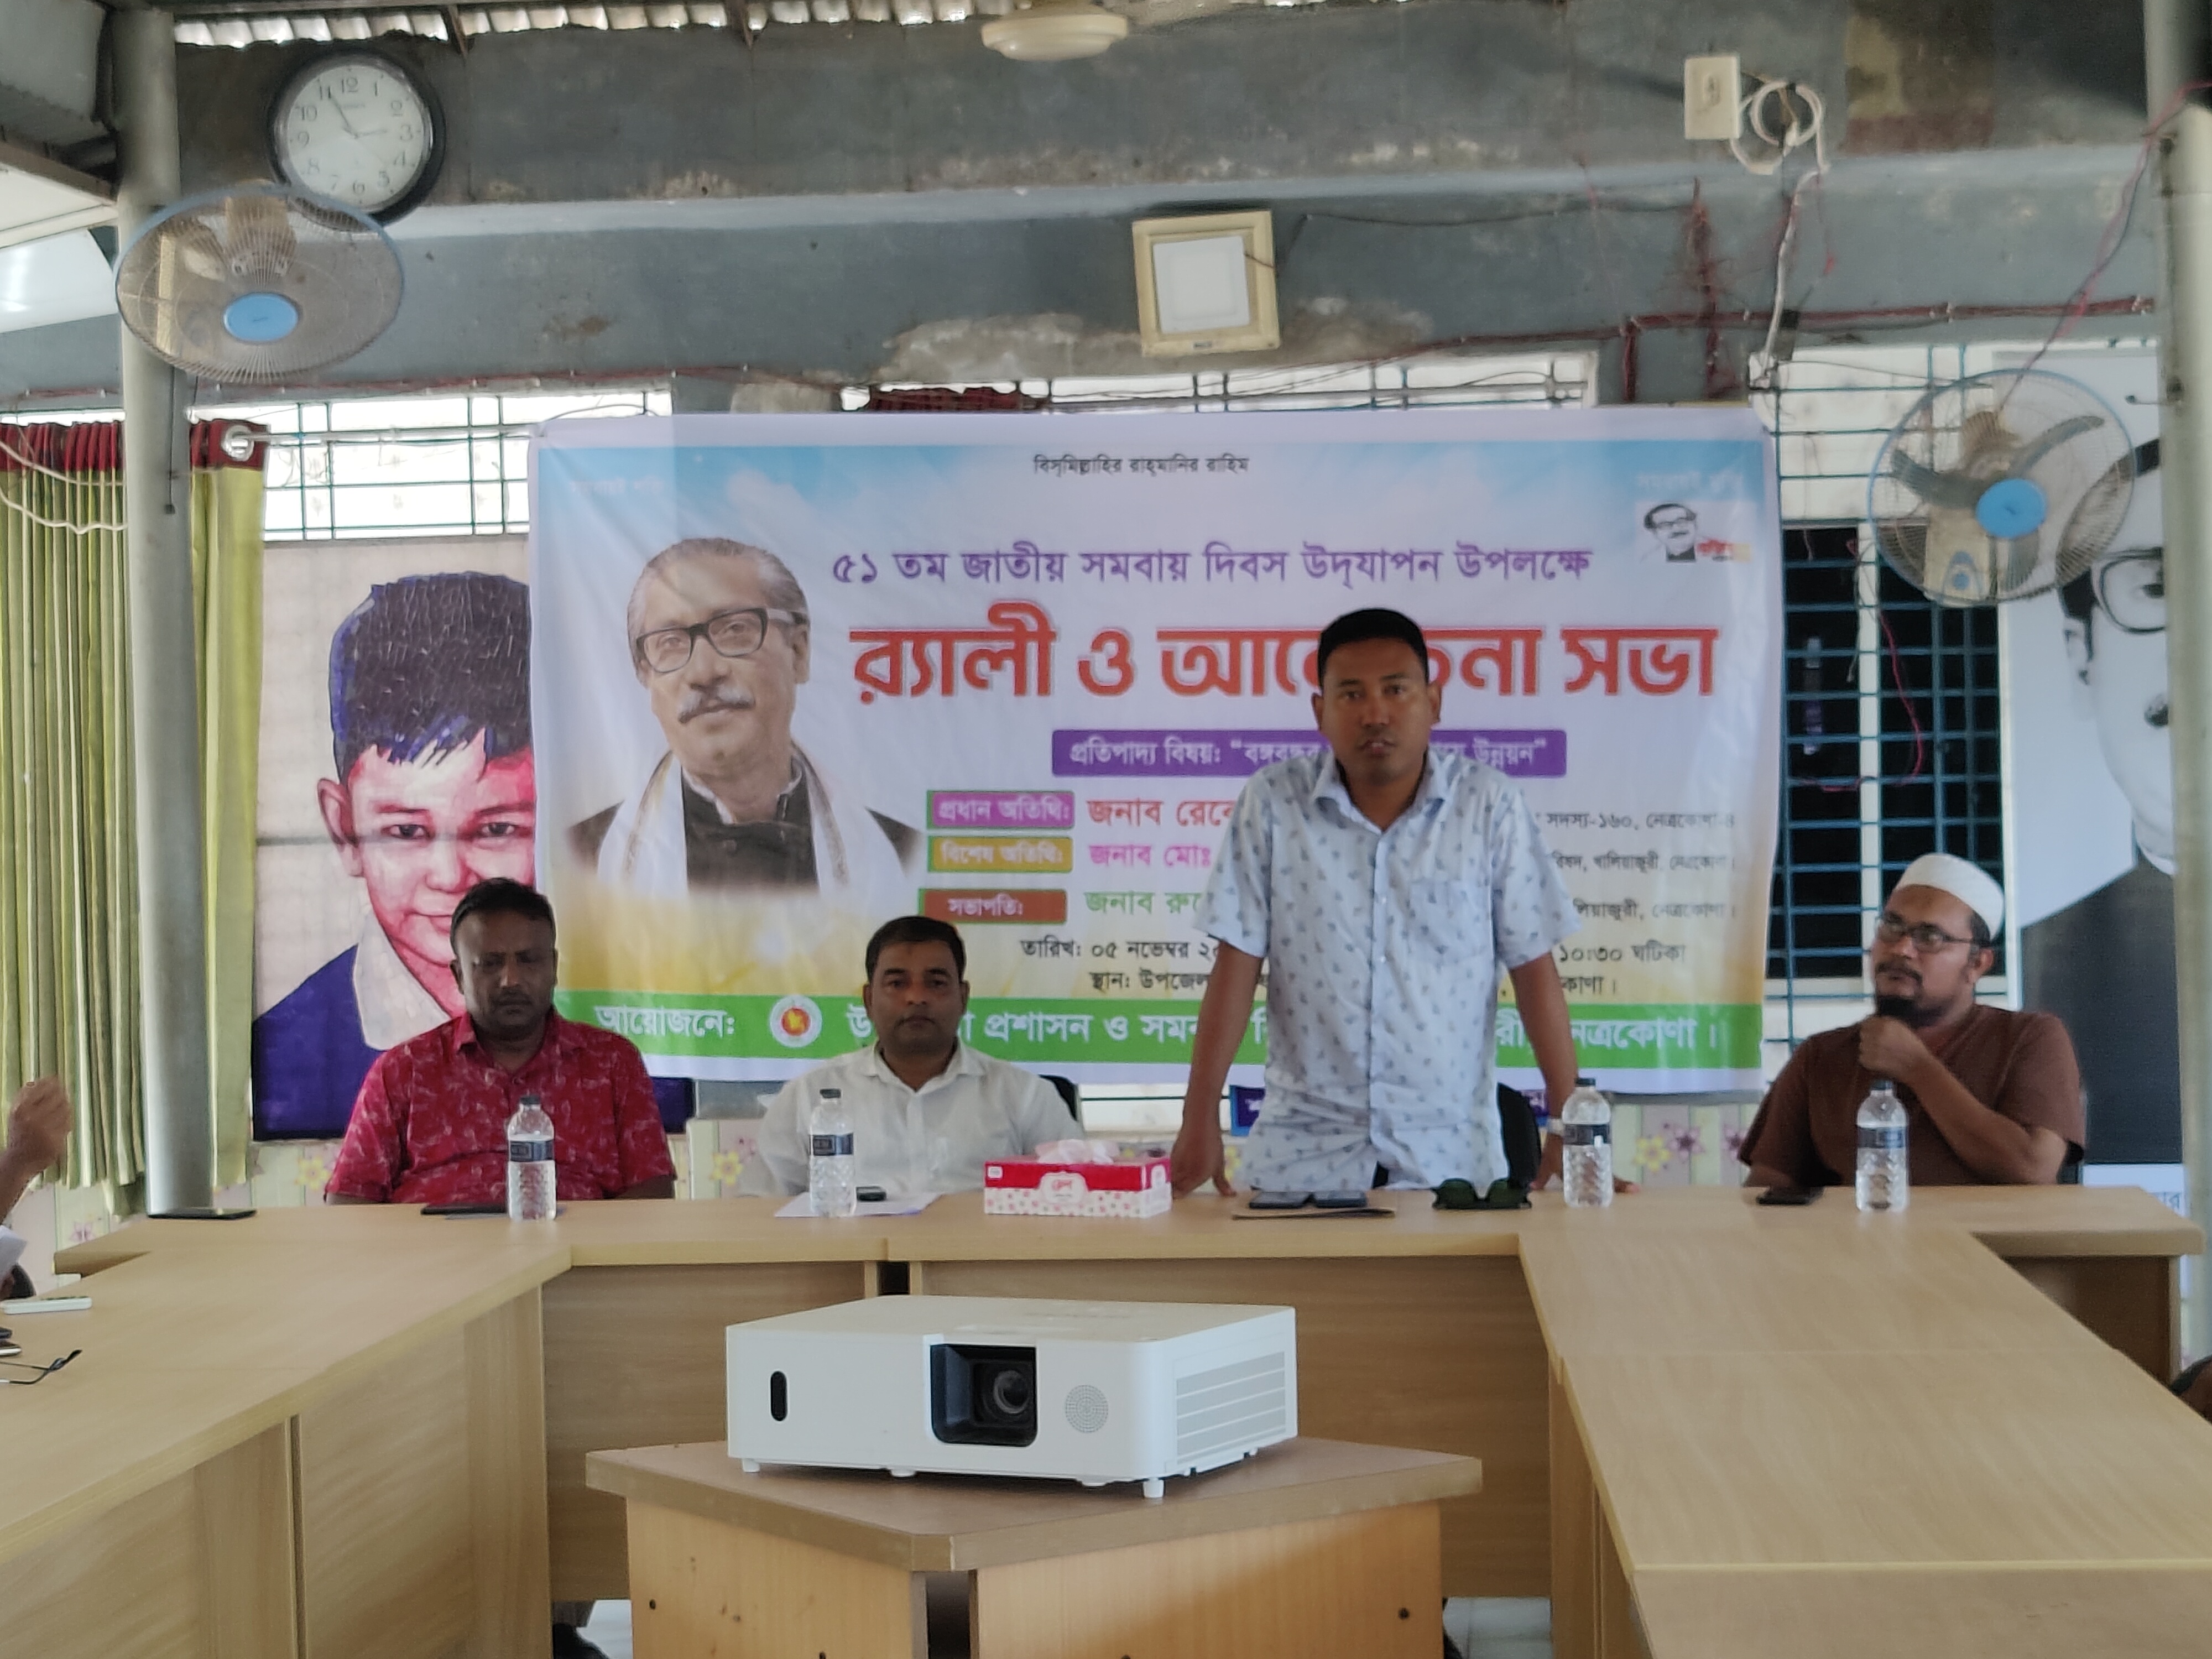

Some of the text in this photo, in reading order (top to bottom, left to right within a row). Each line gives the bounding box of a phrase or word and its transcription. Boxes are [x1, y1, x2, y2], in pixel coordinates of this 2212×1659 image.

[302, 106, 318, 121] 10
[833, 554, 878, 584] ৫১
[893, 553, 951, 583] তম
[961, 540, 1069, 583] জাতীয়
[1079, 549, 1191, 583] সমবায়
[1204, 540, 1288, 582] দিবস
[1455, 540, 1593, 581] উপলক্ষে
[1077, 629, 1136, 697] ও
[1561, 628, 1719, 696] সভা
[1086, 799, 1164, 827] জনাব
[1088, 843, 1152, 868] জনাব
[1084, 890, 1155, 915] জনাব
[1092, 942, 1117, 959] ০৫
[1126, 941, 1190, 958] নভেম্বর
[1630, 939, 1687, 963] ঘটিকা
[984, 1011, 1093, 1043] প্রশাসন
[1104, 1015, 1129, 1042] ও
